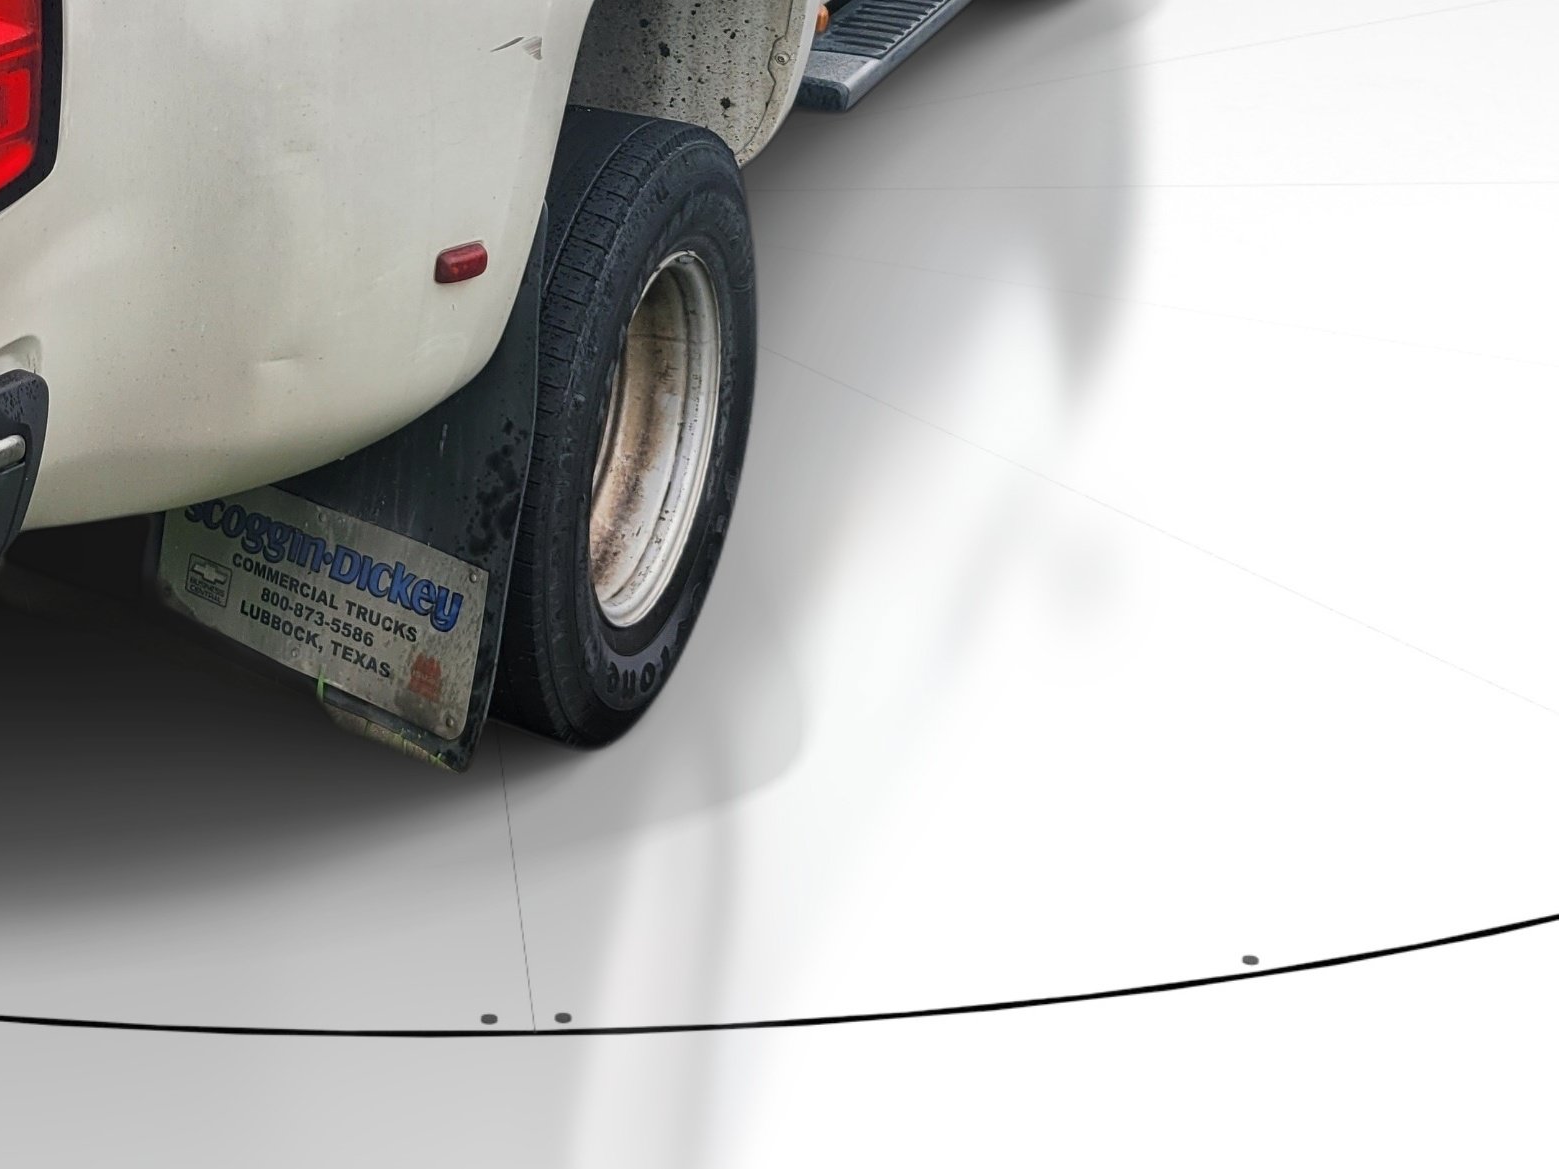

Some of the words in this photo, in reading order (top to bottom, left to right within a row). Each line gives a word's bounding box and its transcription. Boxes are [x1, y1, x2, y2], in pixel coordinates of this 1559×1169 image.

[233, 552, 338, 610] COMMERCIAL
[345, 600, 418, 643] TRUCKS
[260, 586, 374, 647] 800-873-5586
[240, 599, 323, 653] LUBBOCK,
[330, 640, 391, 678] TEXAS
